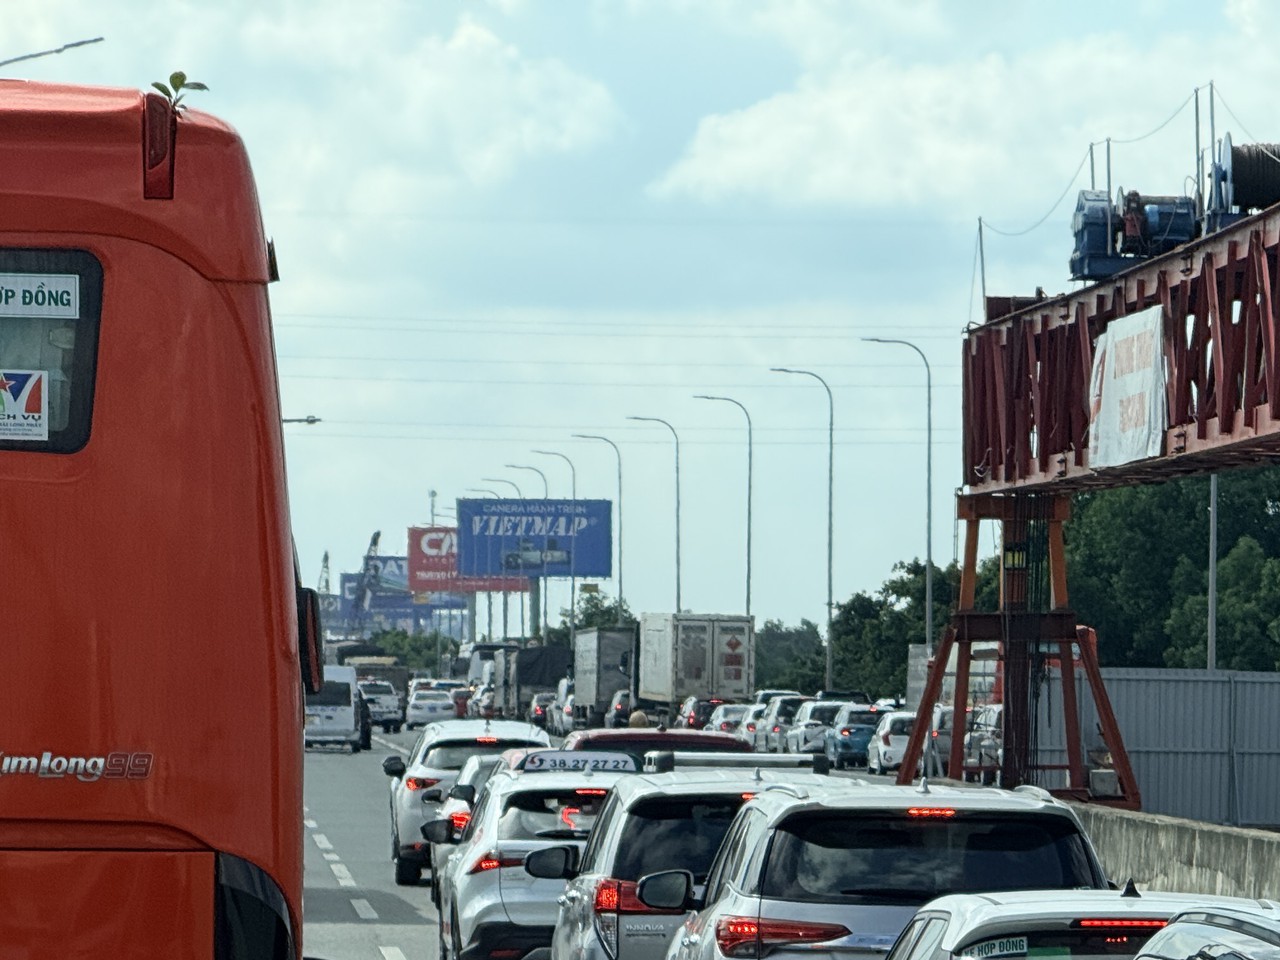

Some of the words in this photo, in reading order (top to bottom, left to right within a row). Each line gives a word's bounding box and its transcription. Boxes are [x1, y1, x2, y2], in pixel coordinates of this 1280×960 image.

[0, 286, 16, 305] P
[22, 282, 71, 307] ĐỒNG
[472, 515, 588, 536] VIETMAP
[593, 760, 608, 769] 27
[612, 760, 629, 769] 27
